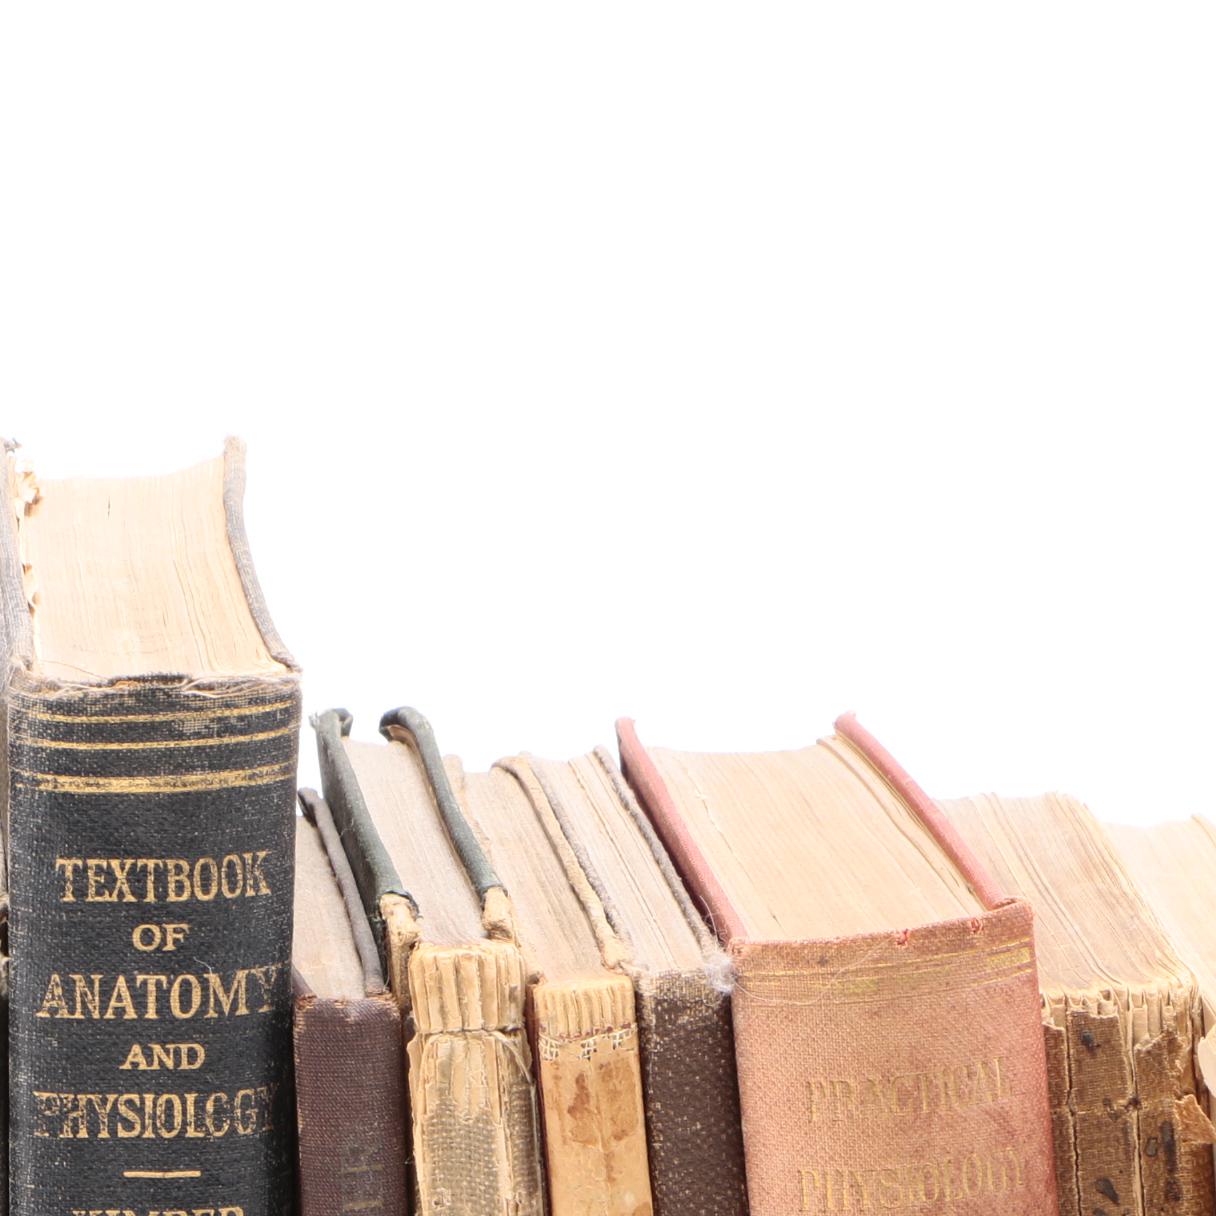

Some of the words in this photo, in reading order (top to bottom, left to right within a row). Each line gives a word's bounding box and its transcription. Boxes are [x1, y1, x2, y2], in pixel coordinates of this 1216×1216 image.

[55, 850, 273, 904] TEXTBOOK
[132, 923, 190, 952] OF
[35, 963, 283, 1020] ANATOMY
[119, 1043, 206, 1070] AND
